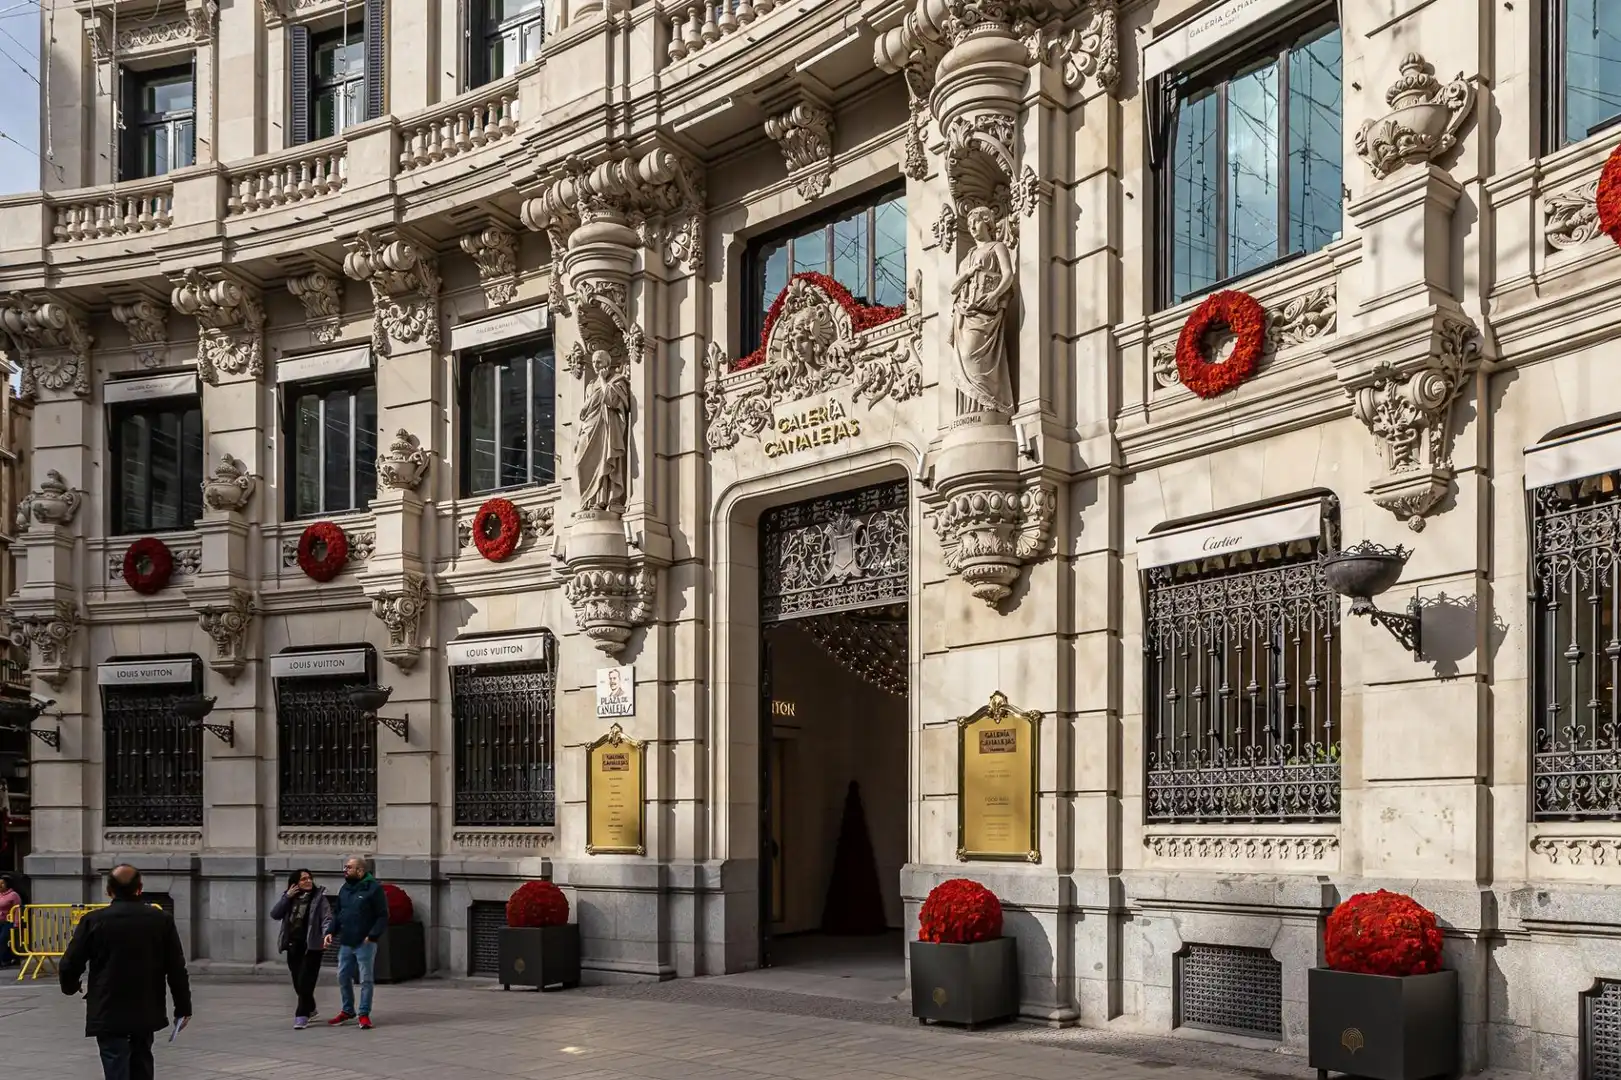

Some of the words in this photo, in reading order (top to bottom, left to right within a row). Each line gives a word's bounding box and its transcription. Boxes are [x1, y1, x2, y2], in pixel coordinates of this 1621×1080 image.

[778, 397, 846, 434] GALERÍA
[764, 419, 861, 458] CANALEJAS
[1202, 536, 1243, 551] Cartier
[466, 648, 488, 658] LOUIS
[490, 645, 523, 655] VUITTON
[289, 661, 311, 670] LOUIS
[313, 660, 345, 668] VUITTON
[116, 670, 139, 678] LOUIS
[140, 669, 173, 677] VUITTON
[600, 696, 620, 705] PLAZA
[597, 703, 632, 716] CANALEJAS
